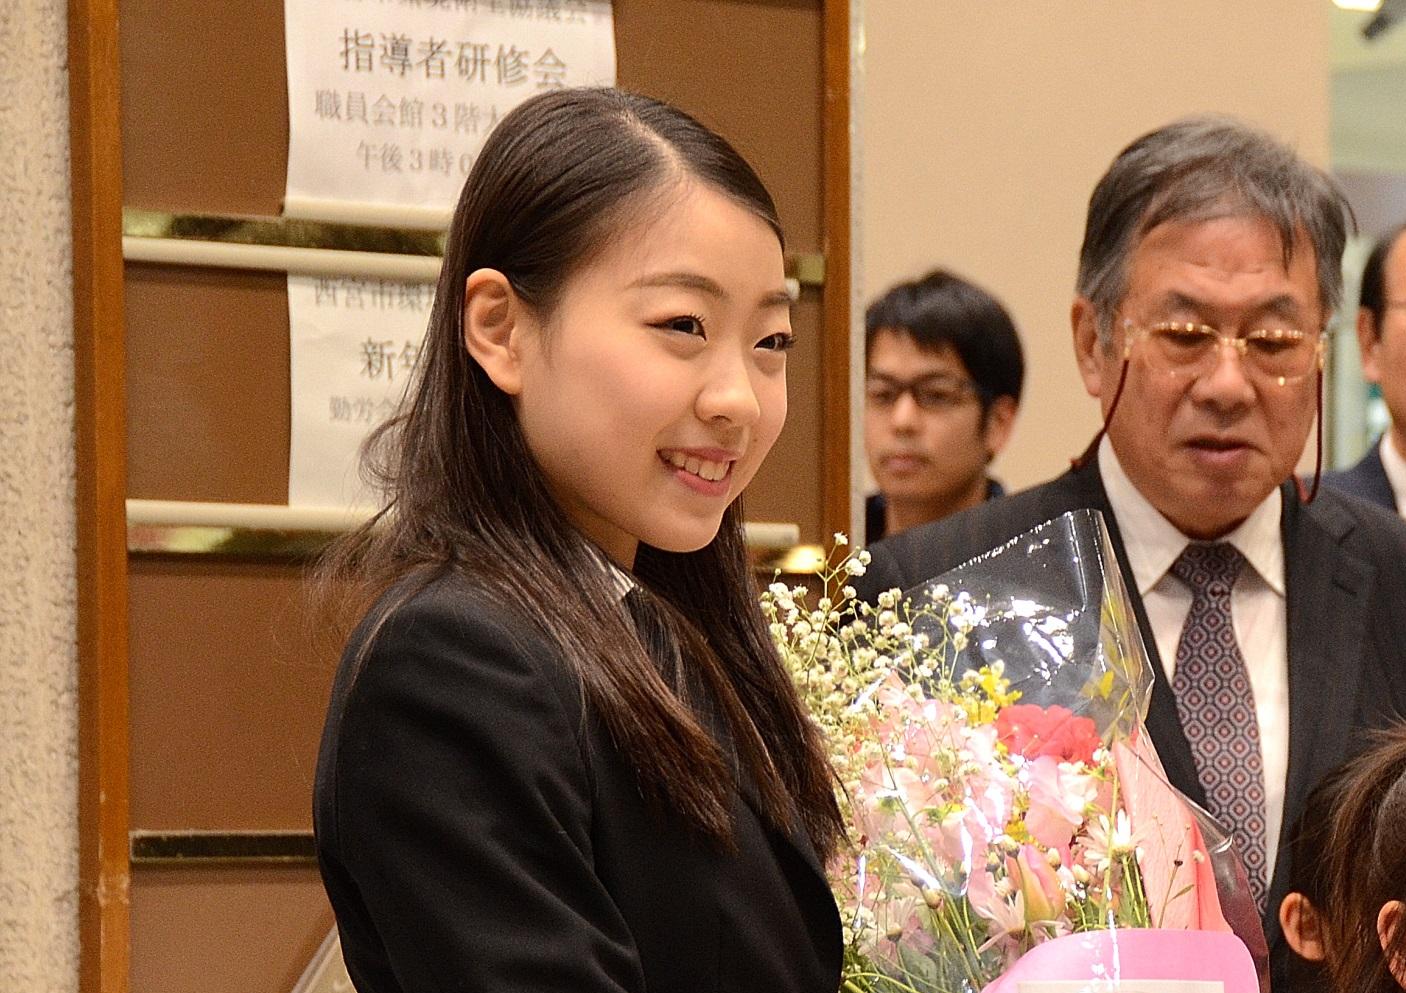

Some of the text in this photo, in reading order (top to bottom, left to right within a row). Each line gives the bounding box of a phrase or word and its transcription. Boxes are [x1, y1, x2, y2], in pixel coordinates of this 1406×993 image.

[340, 27, 568, 87] 指導者研修会
